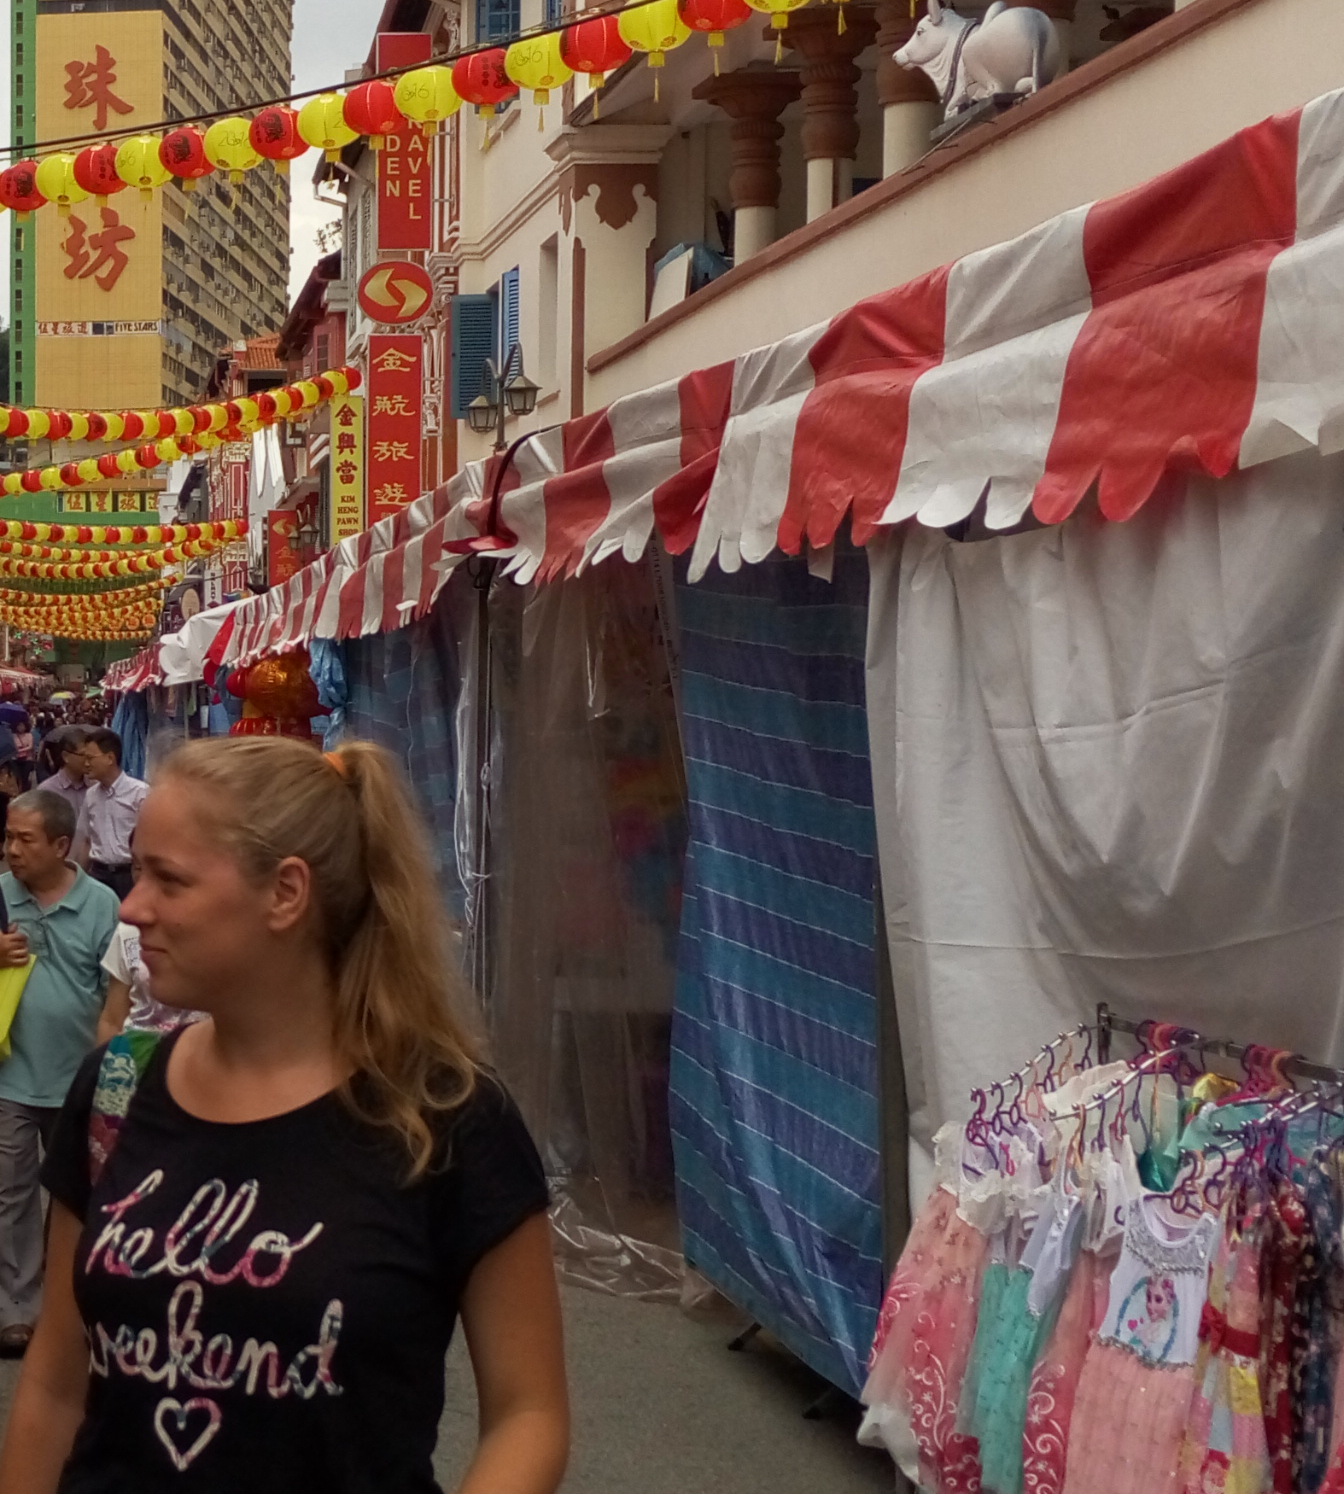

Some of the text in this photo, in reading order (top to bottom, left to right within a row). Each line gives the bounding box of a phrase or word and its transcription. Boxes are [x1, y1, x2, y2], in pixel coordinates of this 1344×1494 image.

[115, 321, 158, 332] FIVE STARS
[340, 495, 355, 503] KIM
[337, 506, 359, 514] HENG
[337, 517, 359, 525] PAWN
[85, 1168, 324, 1288] hello
